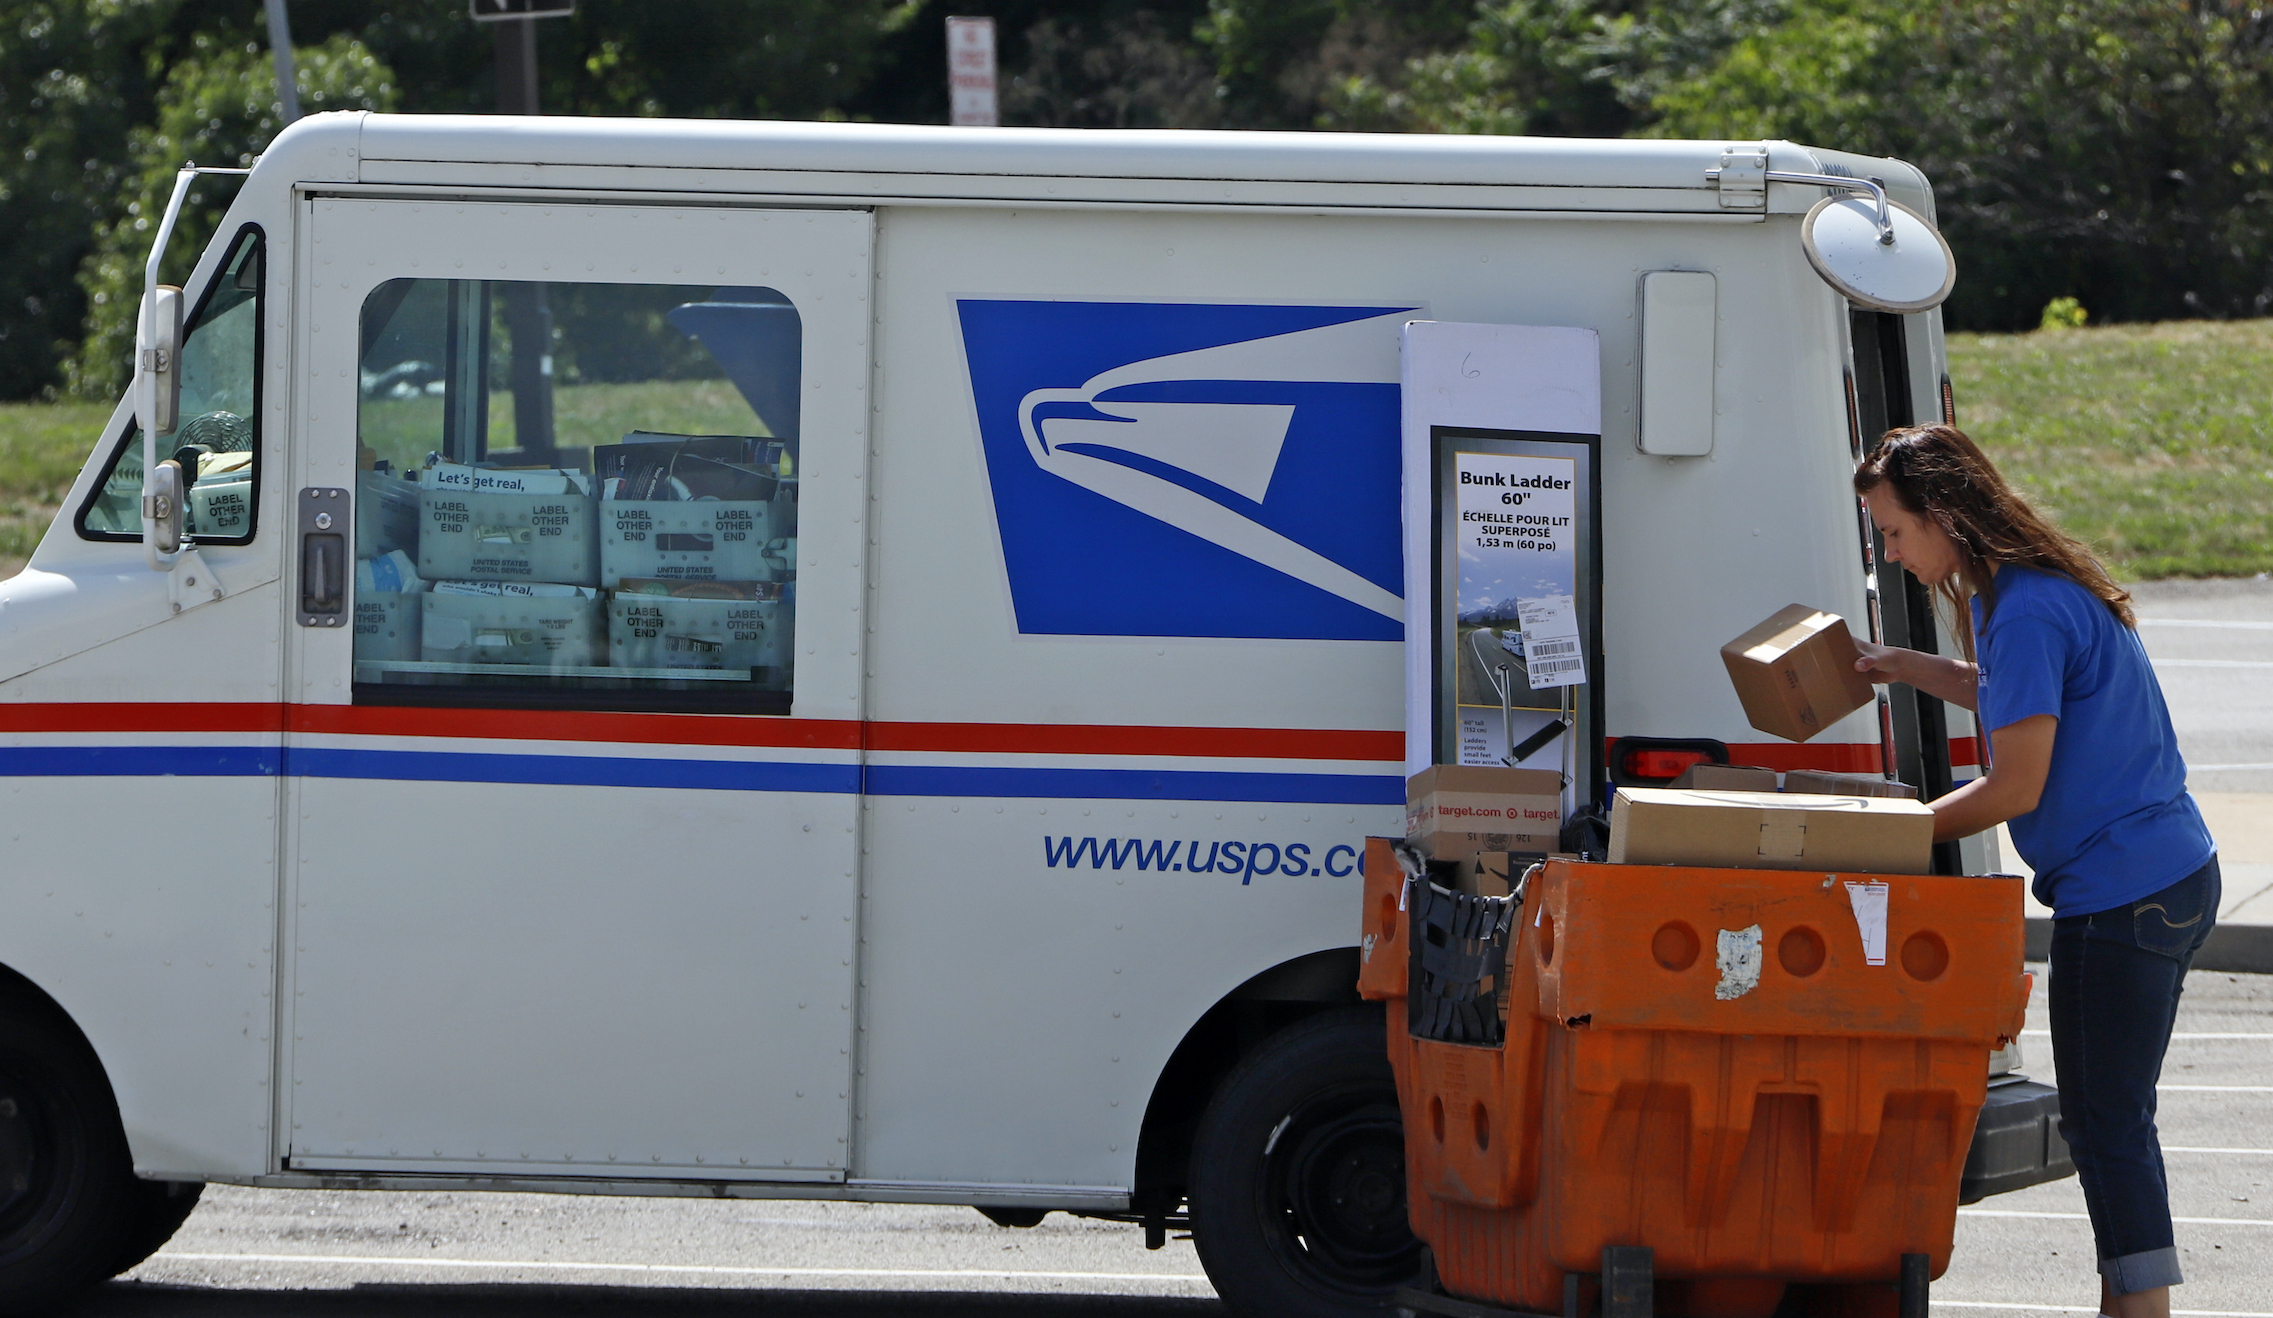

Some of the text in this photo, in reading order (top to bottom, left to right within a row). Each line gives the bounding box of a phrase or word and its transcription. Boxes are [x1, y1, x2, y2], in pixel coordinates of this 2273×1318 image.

[1461, 352, 1480, 378] 6
[438, 472, 470, 484] Let's
[474, 476, 494, 488] get
[497, 479, 524, 492] real,
[1461, 472, 1571, 490] Bunk Ladder
[208, 494, 243, 506] LABEL
[1502, 492, 1530, 505] 60"
[210, 504, 244, 516] OTHER
[434, 502, 468, 512] LABEL
[533, 506, 568, 514] LABEL
[434, 512, 469, 522] OTHER
[617, 510, 651, 520] LABEL
[716, 511, 752, 520] LABEL
[1463, 510, 1570, 526] ÉCHELLE POUR LIT
[218, 516, 240, 526] END
[532, 516, 569, 525] OTHER
[616, 521, 652, 530] OTHER
[716, 521, 753, 530] OTHER
[441, 523, 462, 533] END
[540, 528, 561, 536] END
[1482, 526, 1550, 538] SUPERPOSÉ
[624, 532, 646, 541] END
[724, 532, 746, 541] END
[1476, 538, 1500, 548] 1,53
[1517, 540, 1534, 550] (60
[1538, 541, 1556, 551] po)
[505, 584, 533, 596] real,
[356, 604, 385, 612] ABEL
[628, 607, 662, 616] LABEL
[356, 615, 386, 623] THER
[728, 610, 763, 619] LABEL
[627, 618, 663, 628] OTHER
[727, 620, 764, 630] OTHER
[356, 625, 378, 634] END
[634, 628, 656, 638] END
[734, 632, 756, 640] END
[1439, 805, 1501, 818] target.com
[1524, 808, 1560, 821] target.
